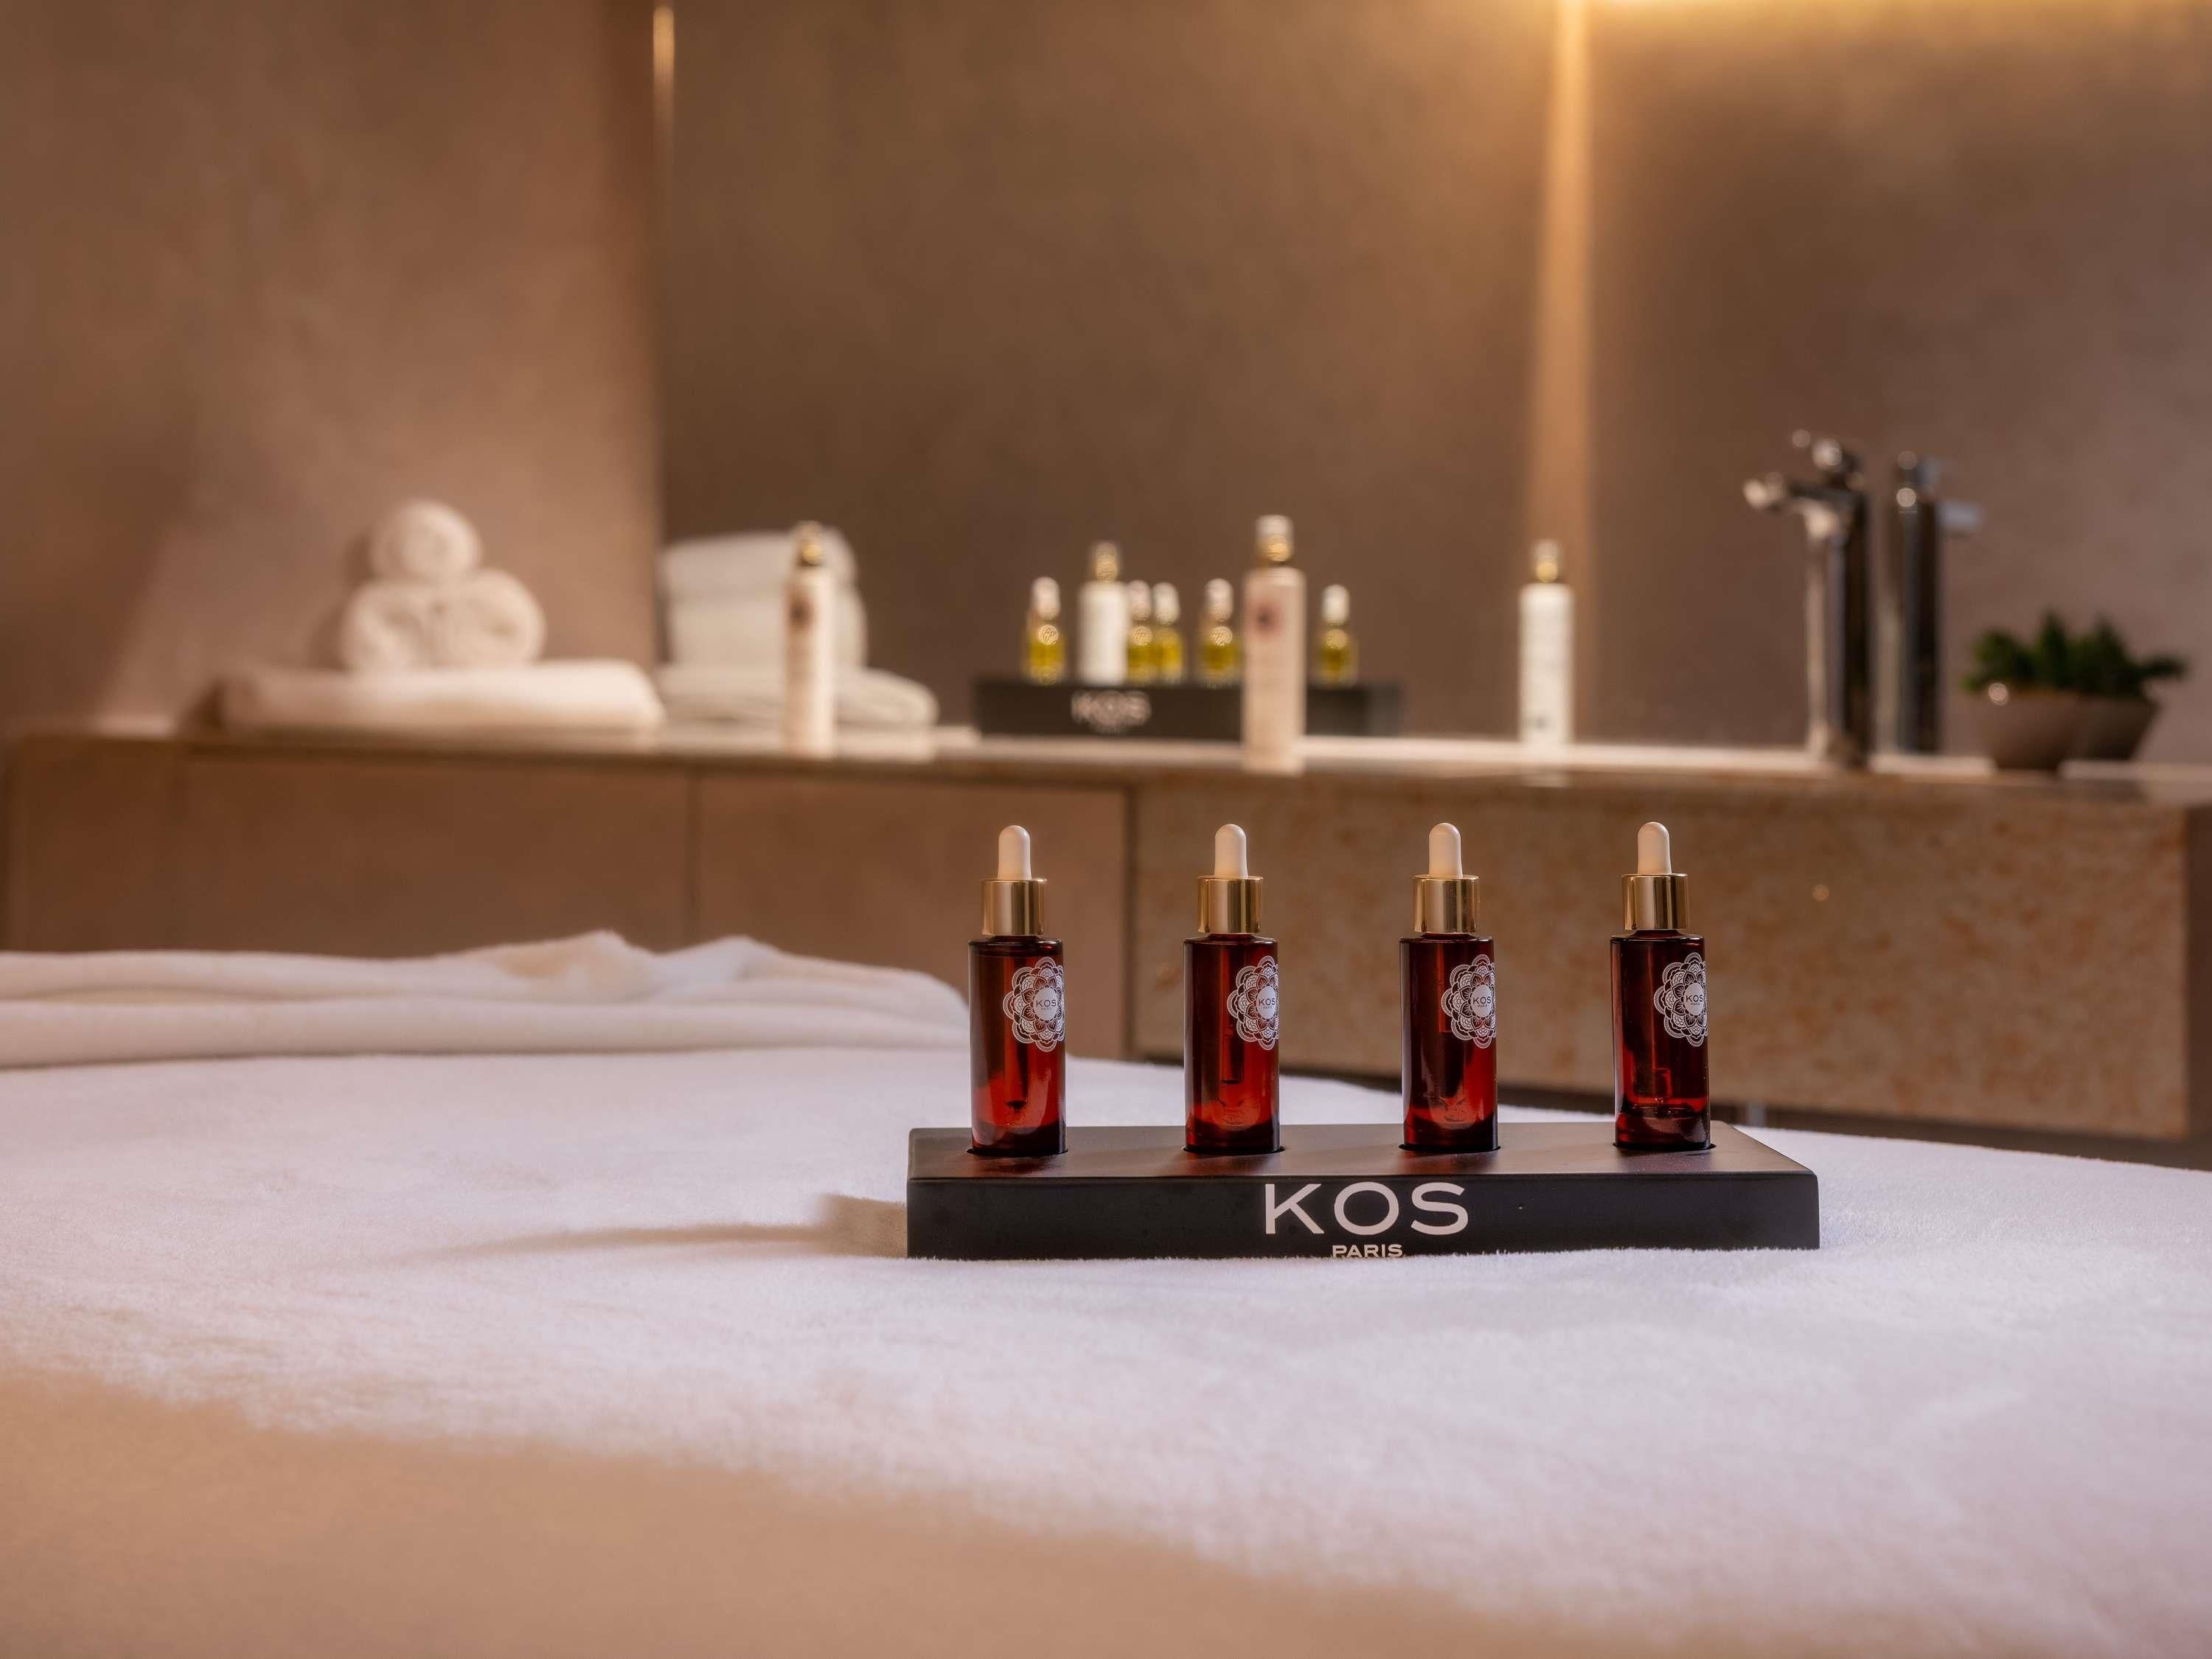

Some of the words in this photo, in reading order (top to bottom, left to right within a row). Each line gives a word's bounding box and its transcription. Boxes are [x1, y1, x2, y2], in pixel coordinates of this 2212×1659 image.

[1036, 999, 1057, 1007] KOS
[1259, 998, 1276, 1006] KOS
[1472, 996, 1491, 1004] KOS
[1686, 995, 1703, 1003] KOS
[1265, 1181, 1468, 1235] KOS
[1332, 1244, 1402, 1258] PARIS
